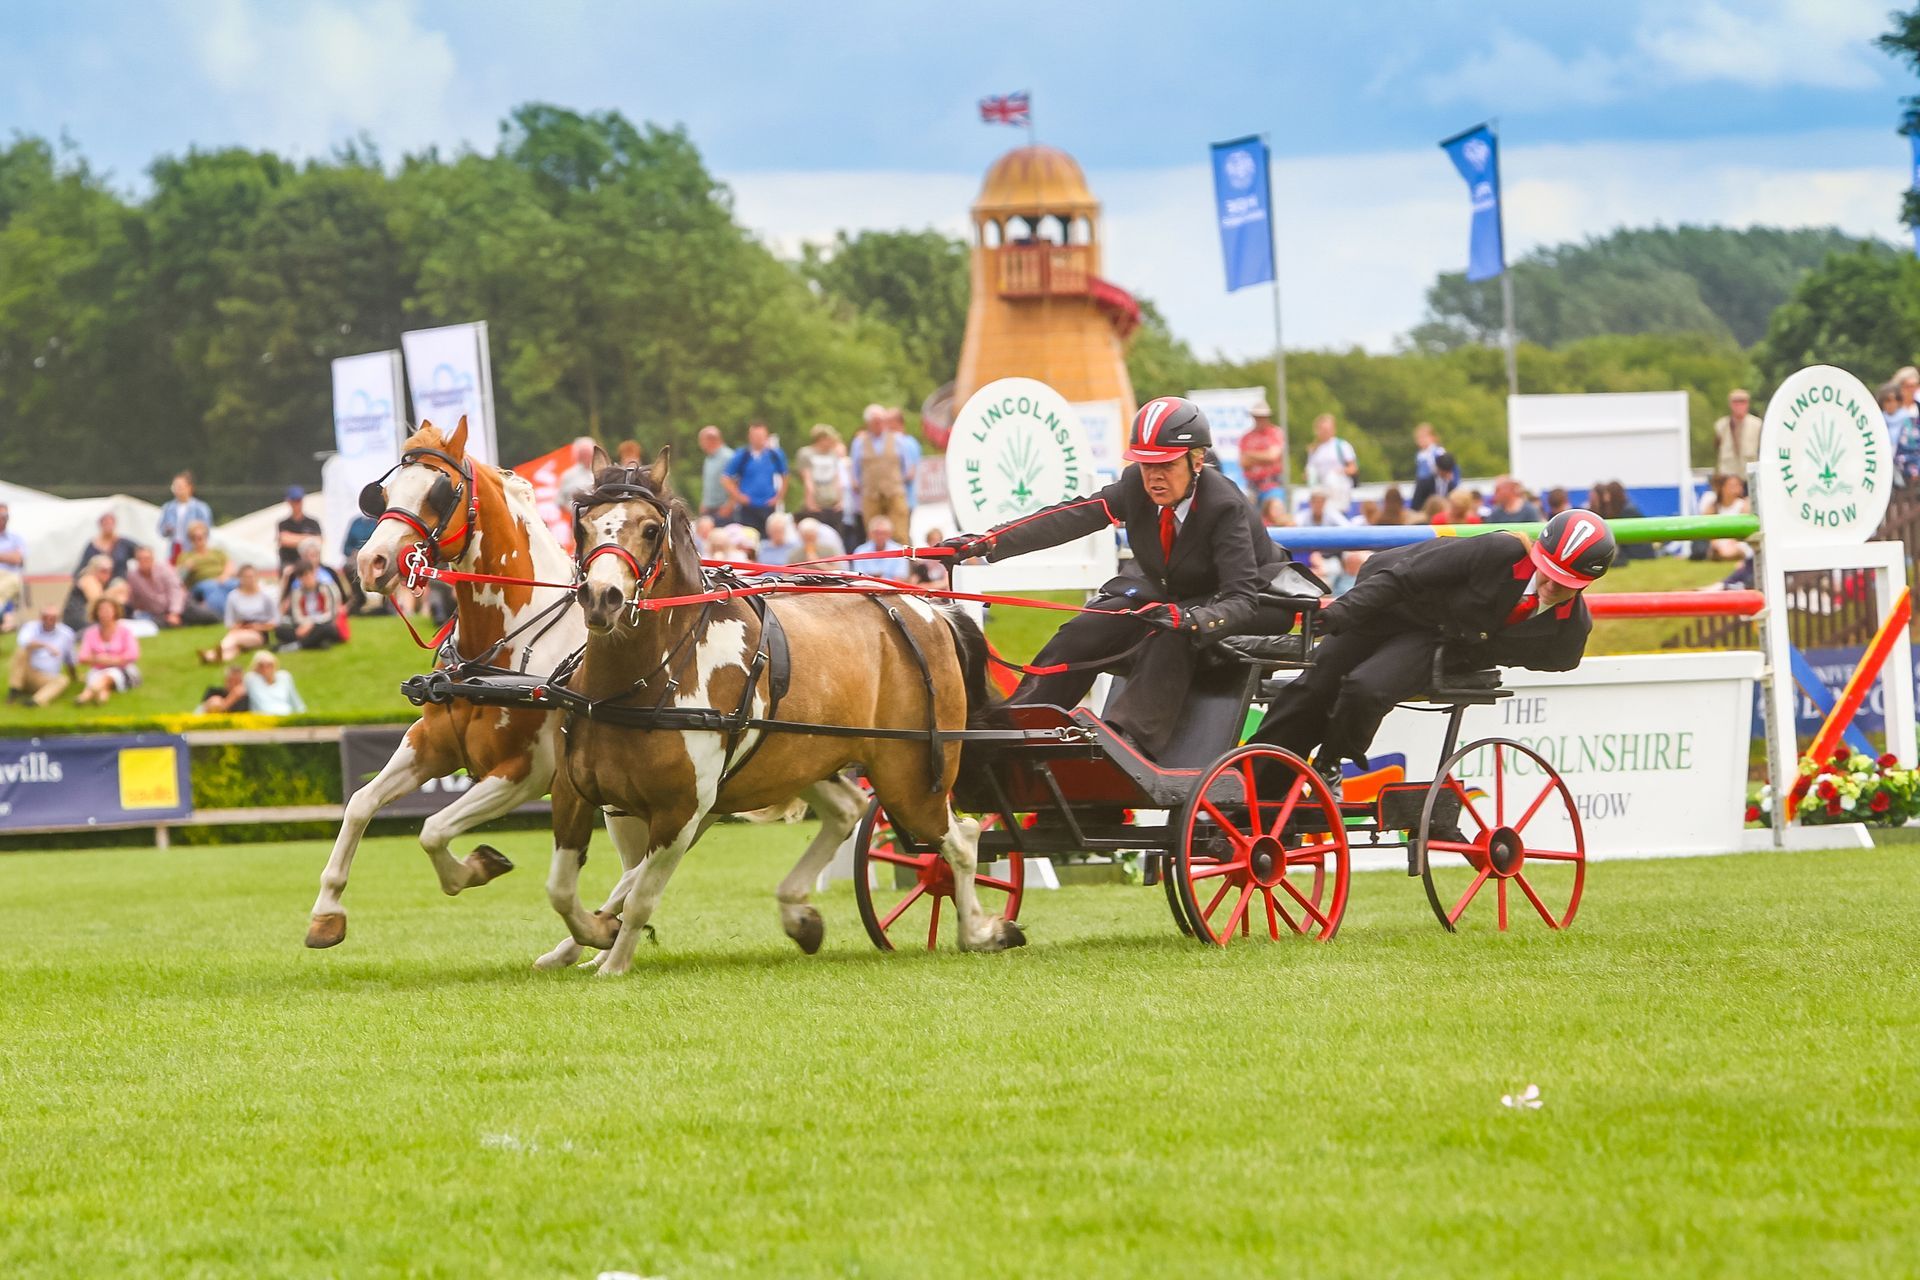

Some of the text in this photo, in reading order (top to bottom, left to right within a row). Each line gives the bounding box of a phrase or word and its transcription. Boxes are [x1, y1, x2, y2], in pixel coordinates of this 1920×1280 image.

[1779, 385, 1877, 498] THE LINCOLNSHIRE
[966, 459, 987, 512] THE
[1800, 503, 1857, 527] SHOW
[1501, 697, 1547, 725] THE
[0, 752, 63, 784] vills
[1562, 793, 1632, 820] HOW
